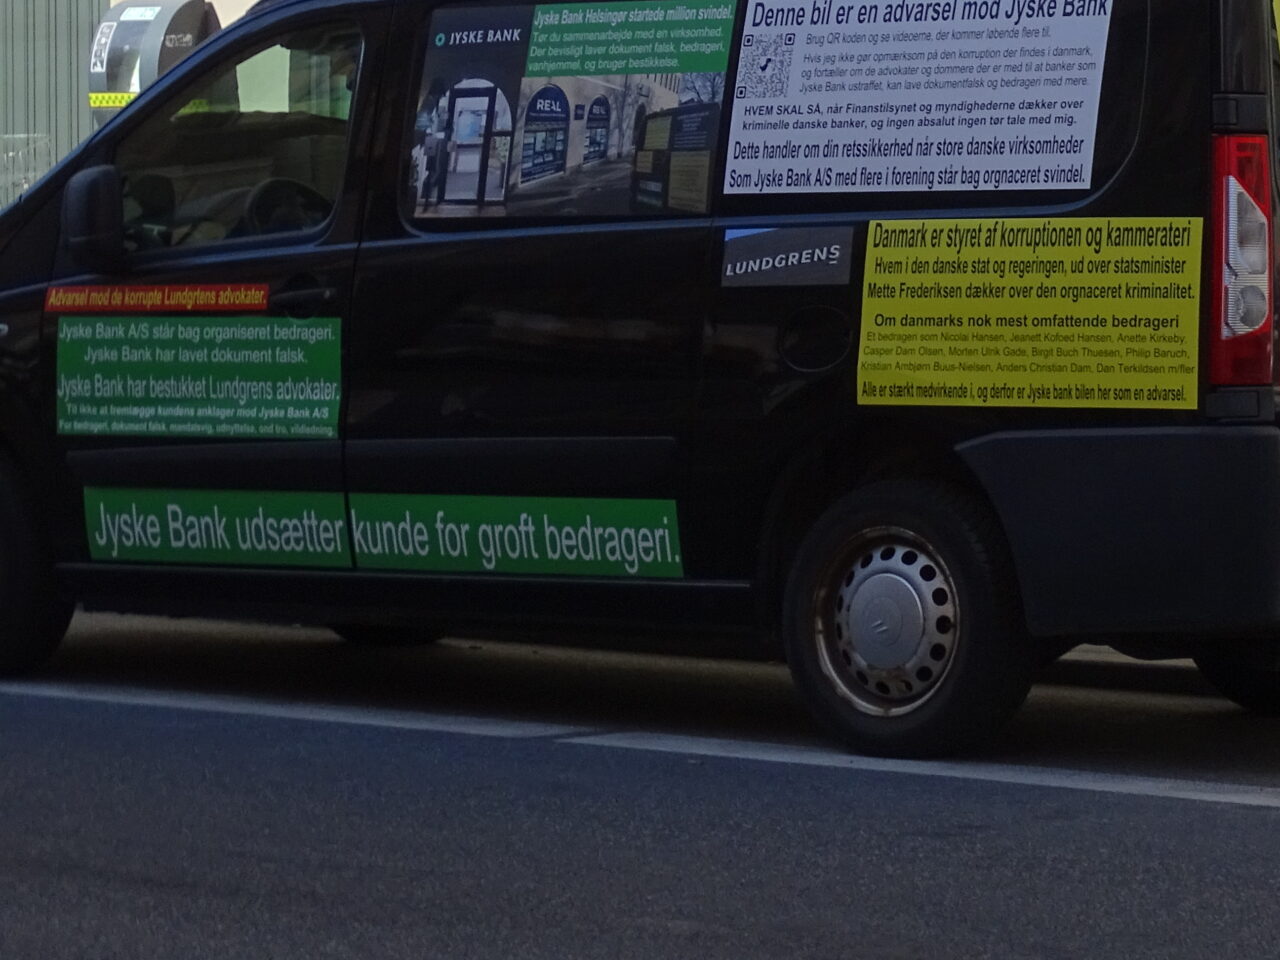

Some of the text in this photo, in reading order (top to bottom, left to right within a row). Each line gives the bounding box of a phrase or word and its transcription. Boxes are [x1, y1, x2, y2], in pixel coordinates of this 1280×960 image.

[752, 2, 805, 27] Denne
[810, 0, 832, 25] bil
[836, 5, 854, 24] er
[857, 4, 878, 24] en
[449, 28, 521, 45] JYSKE BANK
[536, 99, 561, 111] REAL
[734, 135, 1084, 159] Dette handler om din retssikkerhed når store danske virksomheder
[729, 169, 751, 188] Som
[754, 168, 783, 192] Jyske
[786, 168, 811, 187] Bank
[814, 167, 832, 186] A/S
[835, 167, 857, 186] med
[860, 167, 882, 185] flere
[892, 166, 935, 189] forening
[937, 164, 959, 185] står
[961, 165, 980, 188] bag
[983, 165, 1041, 188] orgnaceret
[1043, 163, 1085, 184] svindel.
[873, 220, 1191, 254] Danmark er styret af korruptionen og kammerateri
[726, 245, 840, 276] LUNDGRENS
[868, 282, 1194, 302] Mette Frederiksen dækker over den orgnaceret kriminalitet.
[874, 313, 1179, 331] Om danmarks nok mest omfattende bedrageri
[57, 373, 341, 405] Jyske Bank har bestukket Lundgrens advokater.
[96, 502, 681, 574] Jyske Bank udsætter kunde for groft bedrageri.
